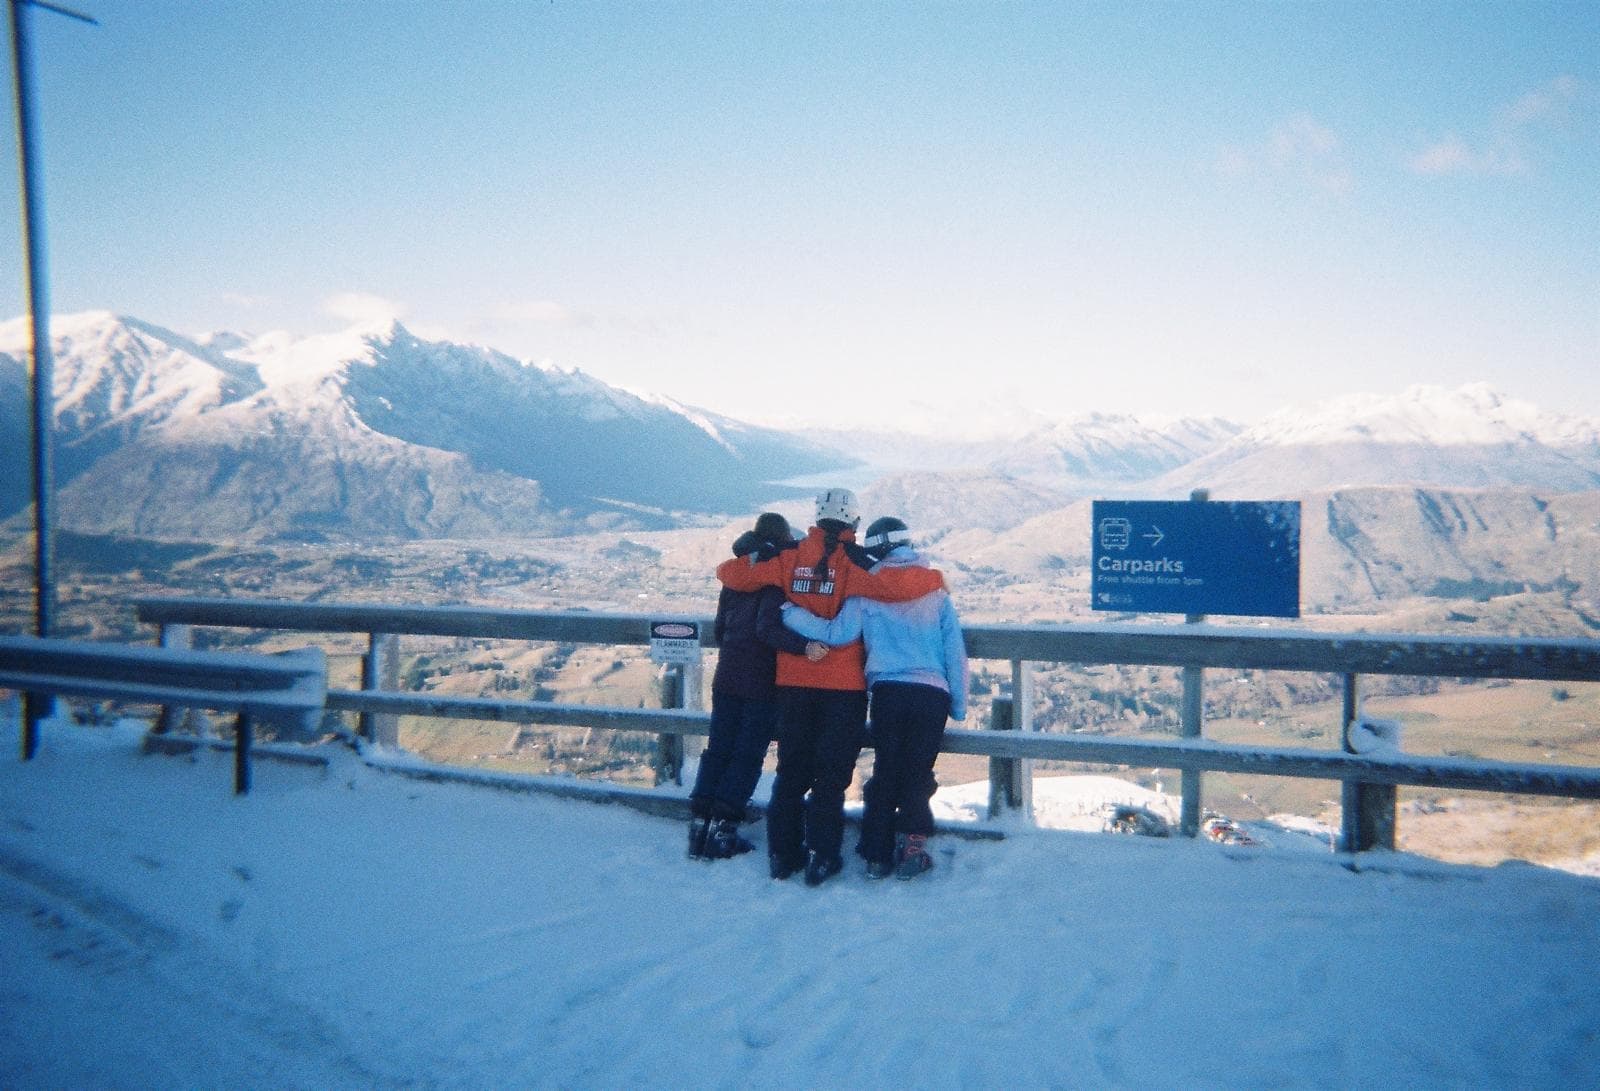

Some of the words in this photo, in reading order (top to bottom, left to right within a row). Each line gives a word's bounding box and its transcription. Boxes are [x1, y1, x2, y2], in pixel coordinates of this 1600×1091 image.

[1098, 556, 1183, 574] Carparks
[1097, 575, 1119, 584] Free
[1121, 576, 1154, 585] shuttle
[1156, 576, 1181, 585] from
